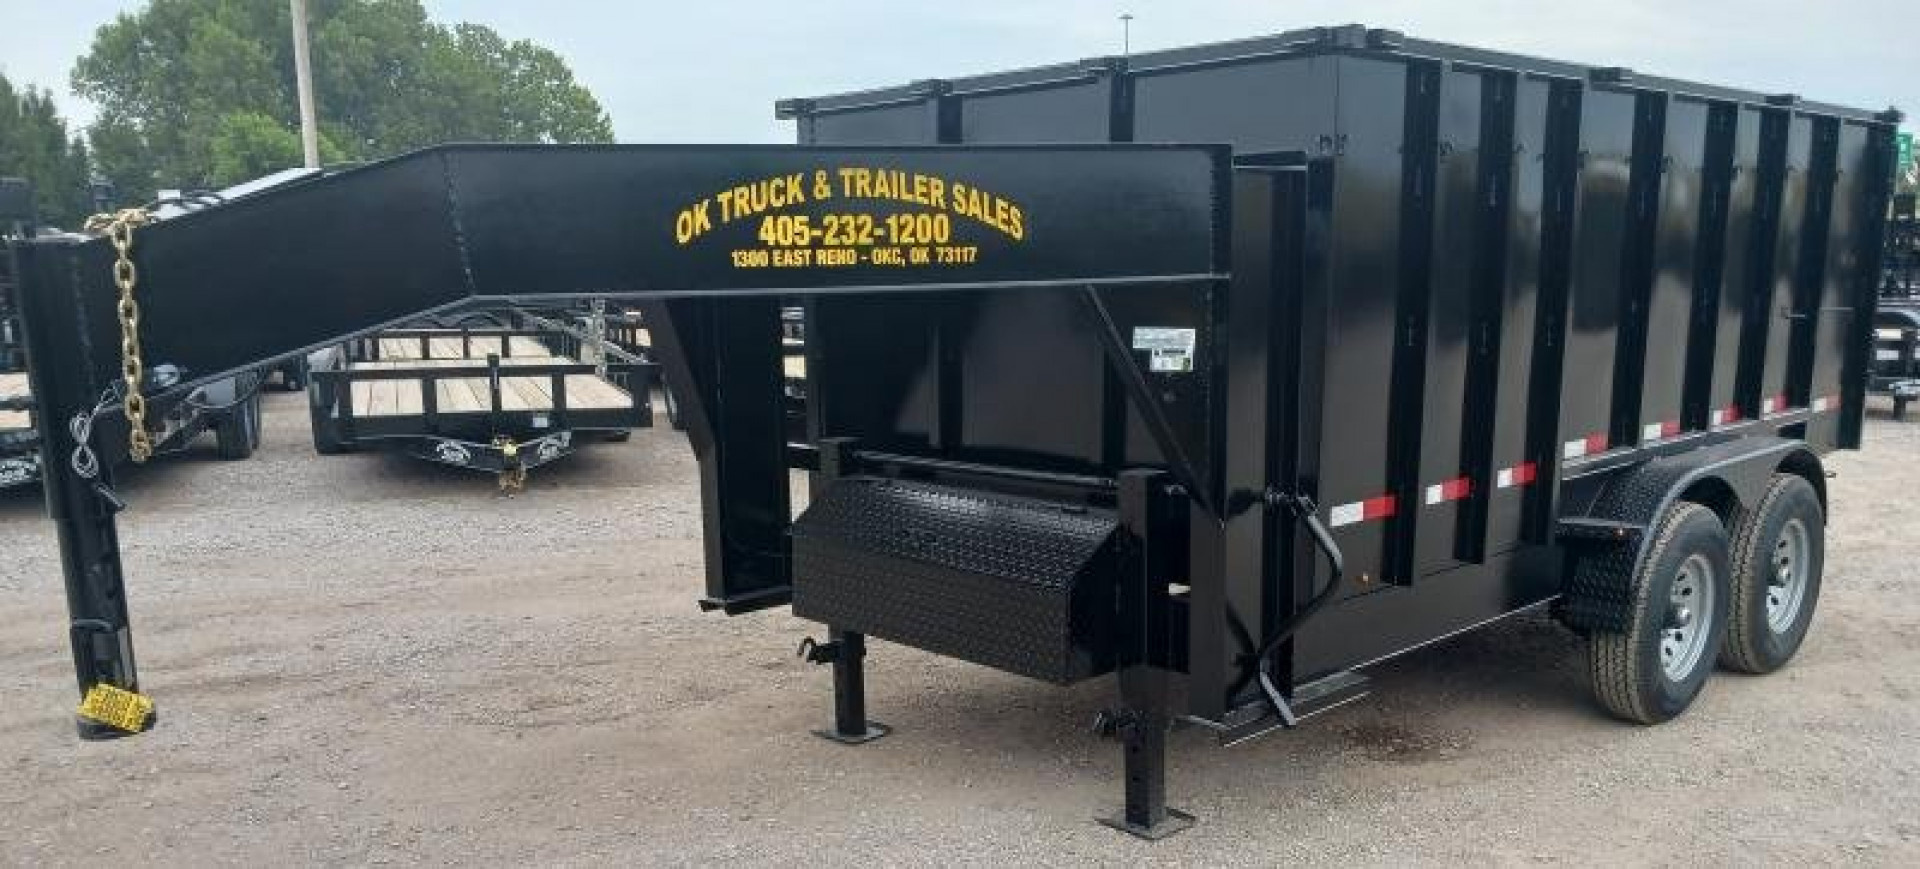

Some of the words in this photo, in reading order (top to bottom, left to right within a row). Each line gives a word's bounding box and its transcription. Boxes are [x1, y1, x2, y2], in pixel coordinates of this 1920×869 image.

[676, 199, 711, 243] OK
[717, 173, 805, 222] TRUCK
[814, 169, 832, 200] &
[840, 167, 947, 209] TRAILER
[952, 182, 1024, 241] SALES
[758, 214, 950, 247] 405-232-1200
[772, 249, 812, 267] EAST
[815, 249, 857, 266] RENO
[909, 247, 931, 265] OK
[935, 247, 978, 264] 73117
